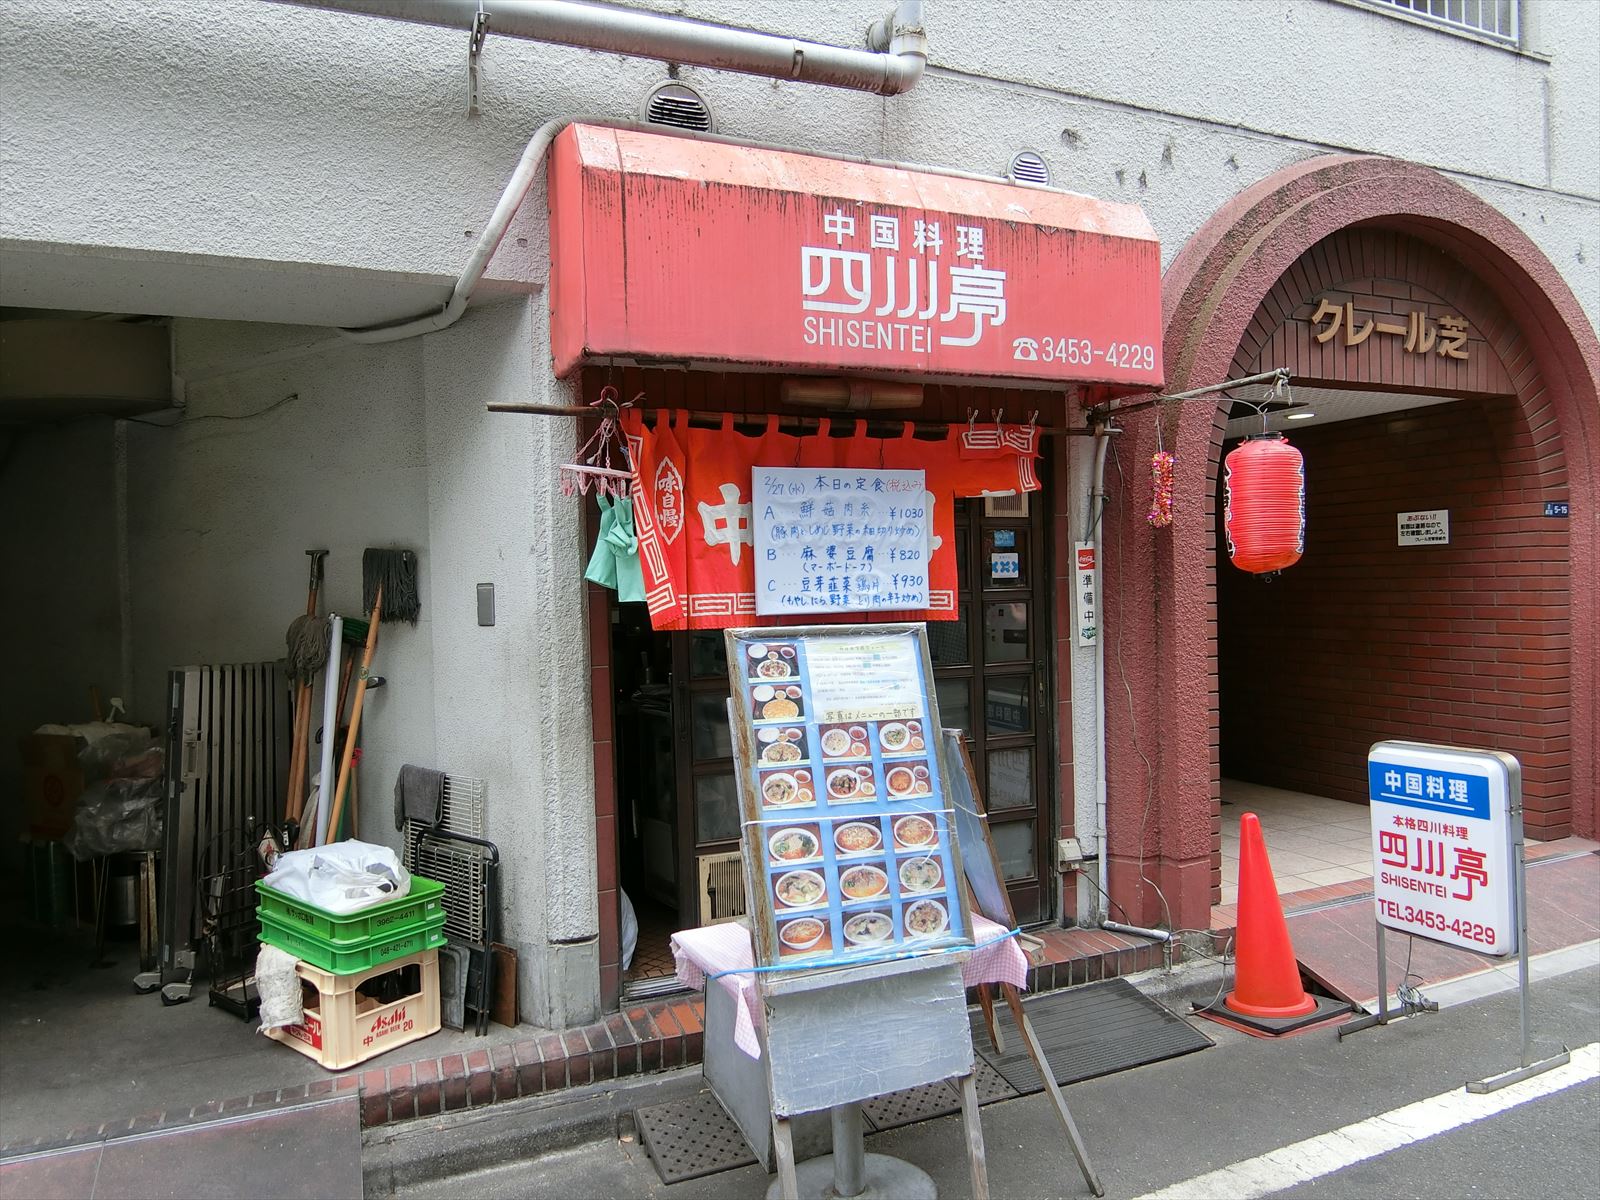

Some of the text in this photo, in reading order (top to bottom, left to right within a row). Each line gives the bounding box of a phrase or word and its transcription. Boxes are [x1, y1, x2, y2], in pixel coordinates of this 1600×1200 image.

[824, 209, 985, 261] 中国料理
[801, 246, 1007, 347] 四川亭
[803, 316, 932, 354] SHISENTEI
[1311, 298, 1469, 360] クレール芝
[1042, 336, 1154, 371] 3453-4229
[658, 471, 679, 528] 味自慢
[813, 475, 885, 494] 本日の定食
[764, 505, 775, 520] A
[889, 506, 924, 520] ¥1030
[767, 545, 921, 563] B 麻婆豆腐 ¥820
[767, 579, 776, 592] C
[891, 573, 924, 589] ¥930
[1083, 574, 1095, 623] 準備中
[1384, 769, 1469, 803] 中国料理
[1392, 814, 1469, 841] 本格四川料理
[1379, 830, 1489, 902] 四川亭
[1381, 871, 1447, 899] SHISENTEI
[1378, 898, 1496, 946] TEL3453-4229
[371, 1005, 406, 1033] Asahi
[403, 1019, 413, 1032] 20
[362, 1035, 374, 1047] 中
